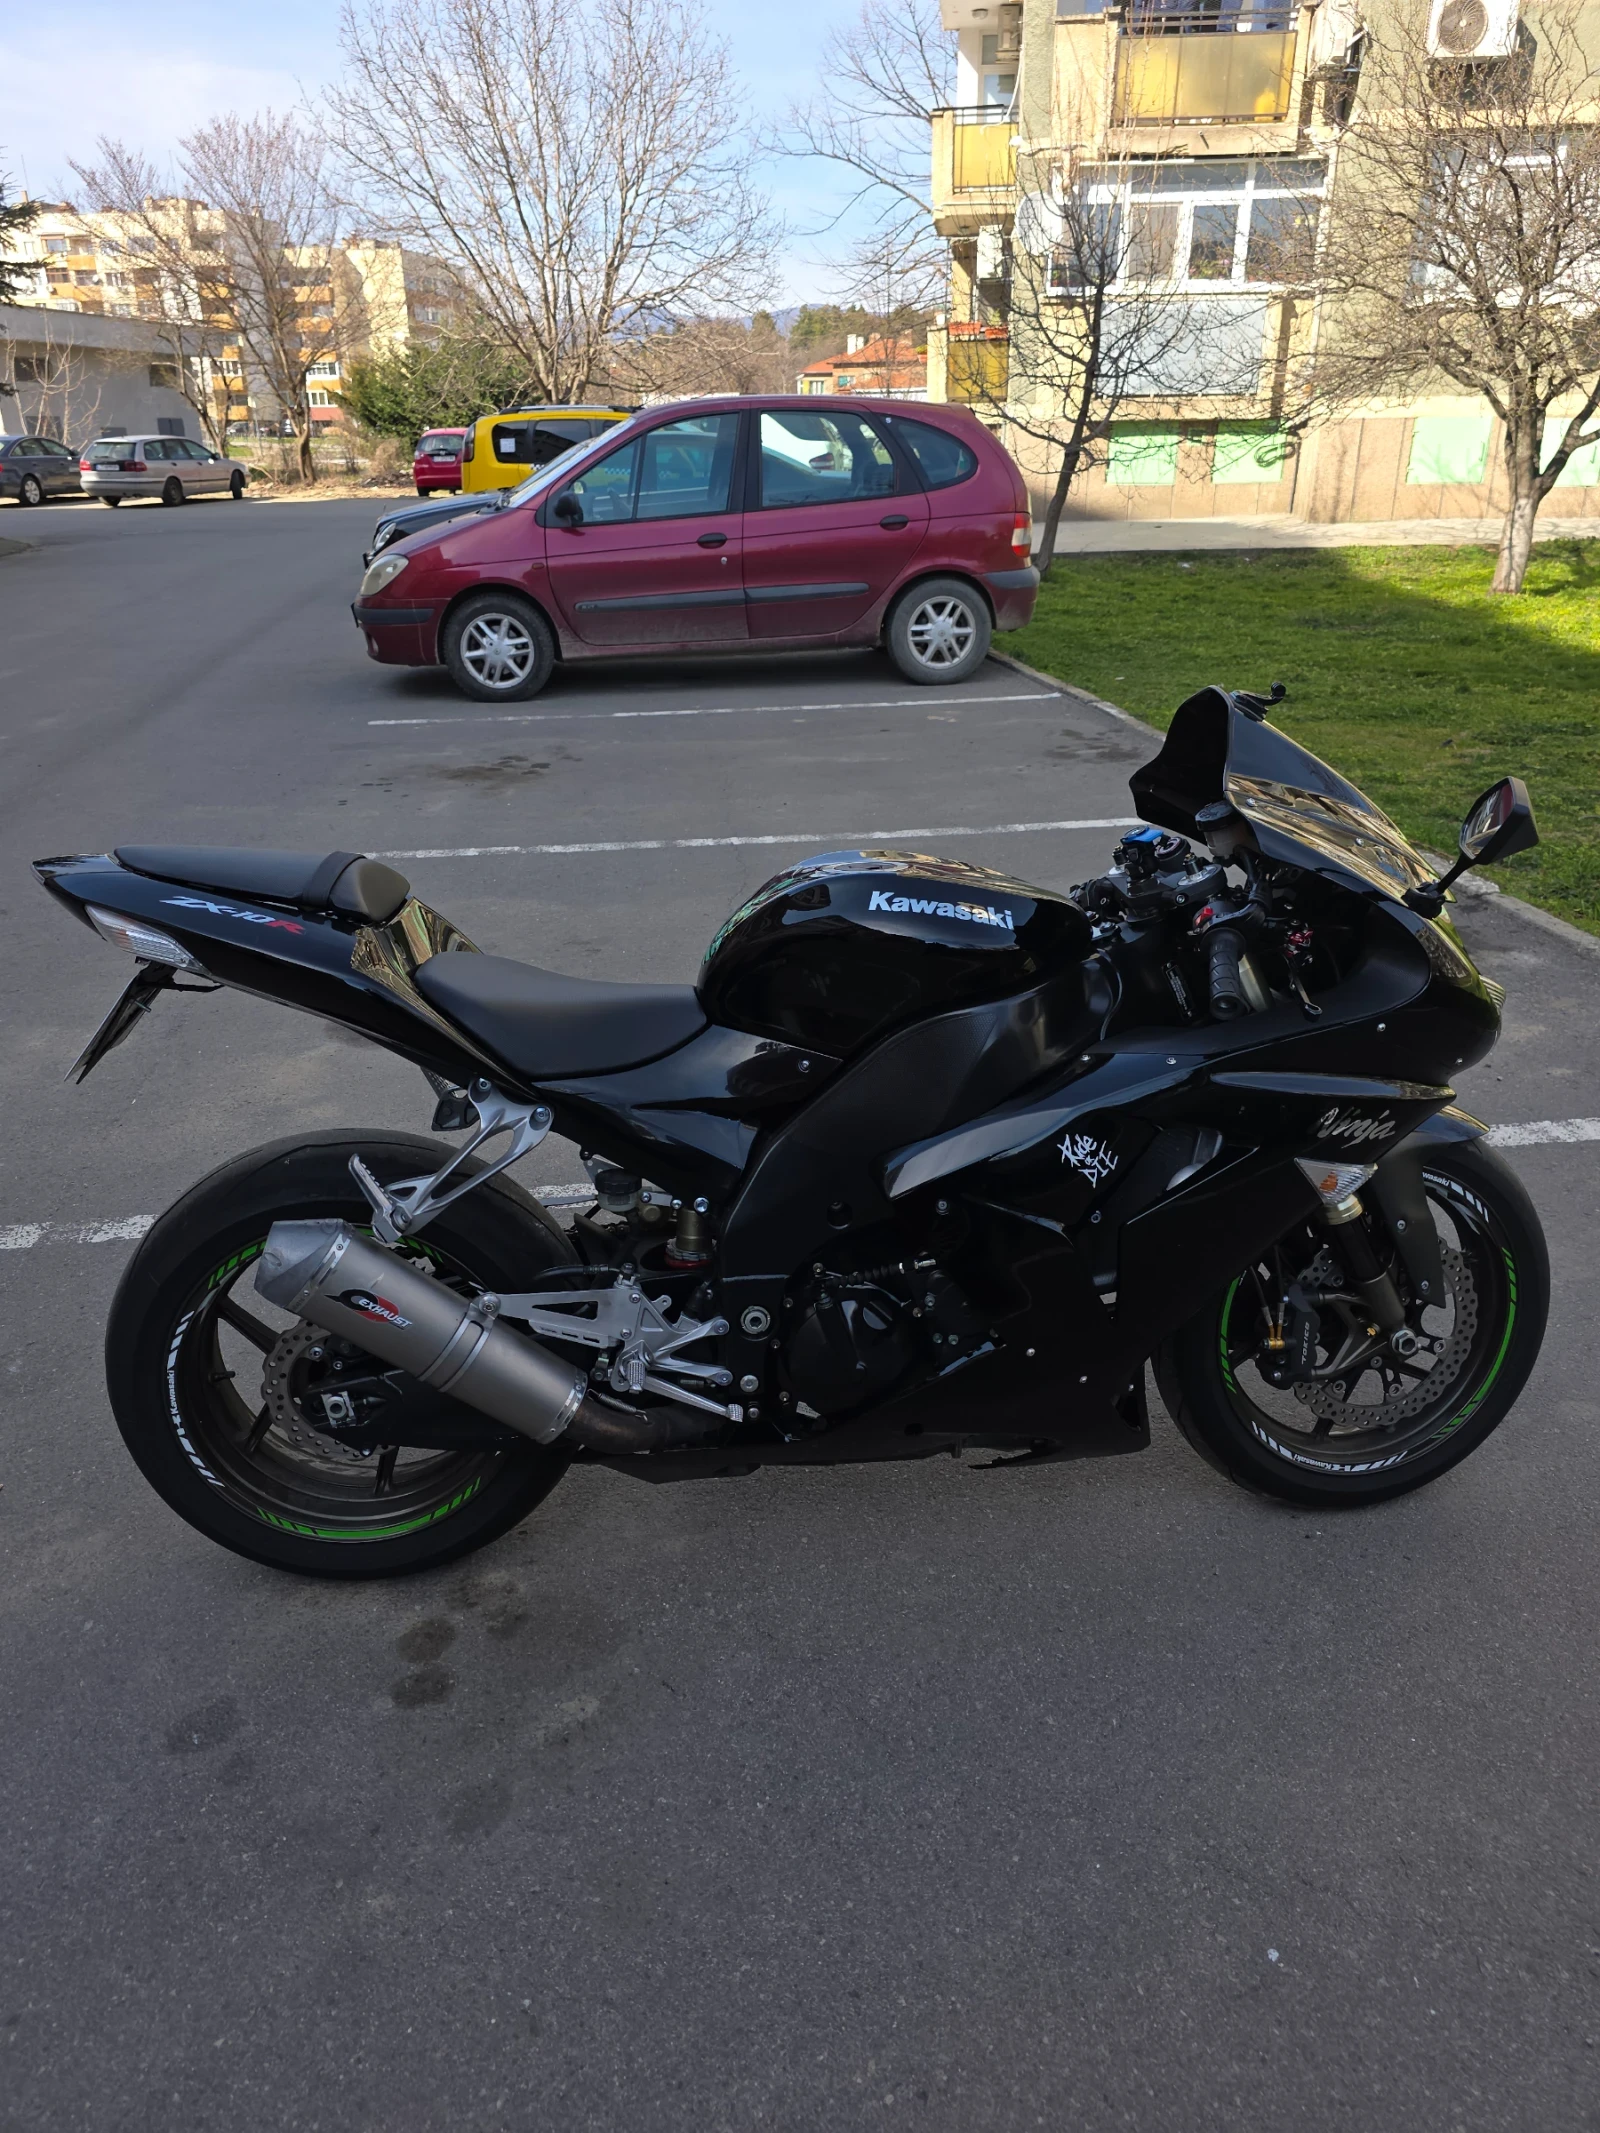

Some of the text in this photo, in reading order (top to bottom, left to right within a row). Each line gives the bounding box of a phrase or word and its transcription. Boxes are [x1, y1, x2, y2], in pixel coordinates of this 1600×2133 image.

[158, 895, 306, 935] ZX-10R
[868, 890, 1015, 930] Kawasaki
[1317, 1106, 1396, 1149] Ninja
[1422, 1171, 1450, 1187] wasaki
[358, 1298, 414, 1328] EXHAUST
[1301, 1321, 1310, 1365] TOKICO
[166, 1370, 179, 1415] Kawasaki
[1293, 1453, 1332, 1471] Kawasaki
